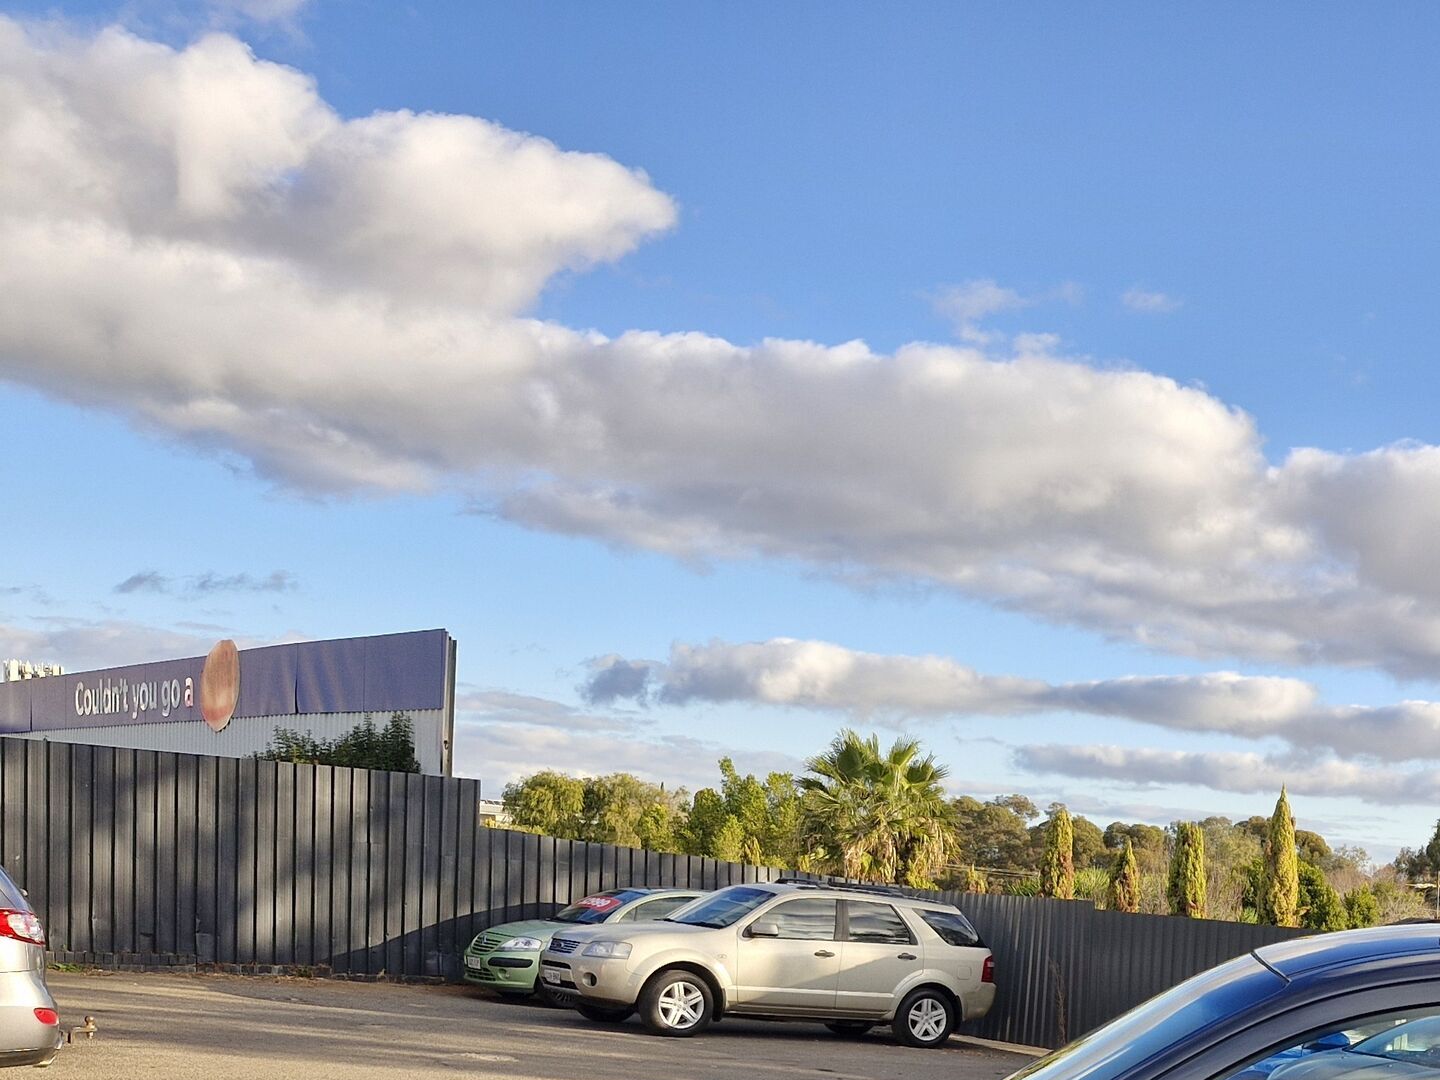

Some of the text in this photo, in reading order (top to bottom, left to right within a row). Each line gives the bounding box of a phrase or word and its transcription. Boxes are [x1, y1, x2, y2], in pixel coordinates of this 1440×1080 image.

[75, 677, 193, 719] Couldn't you go a
